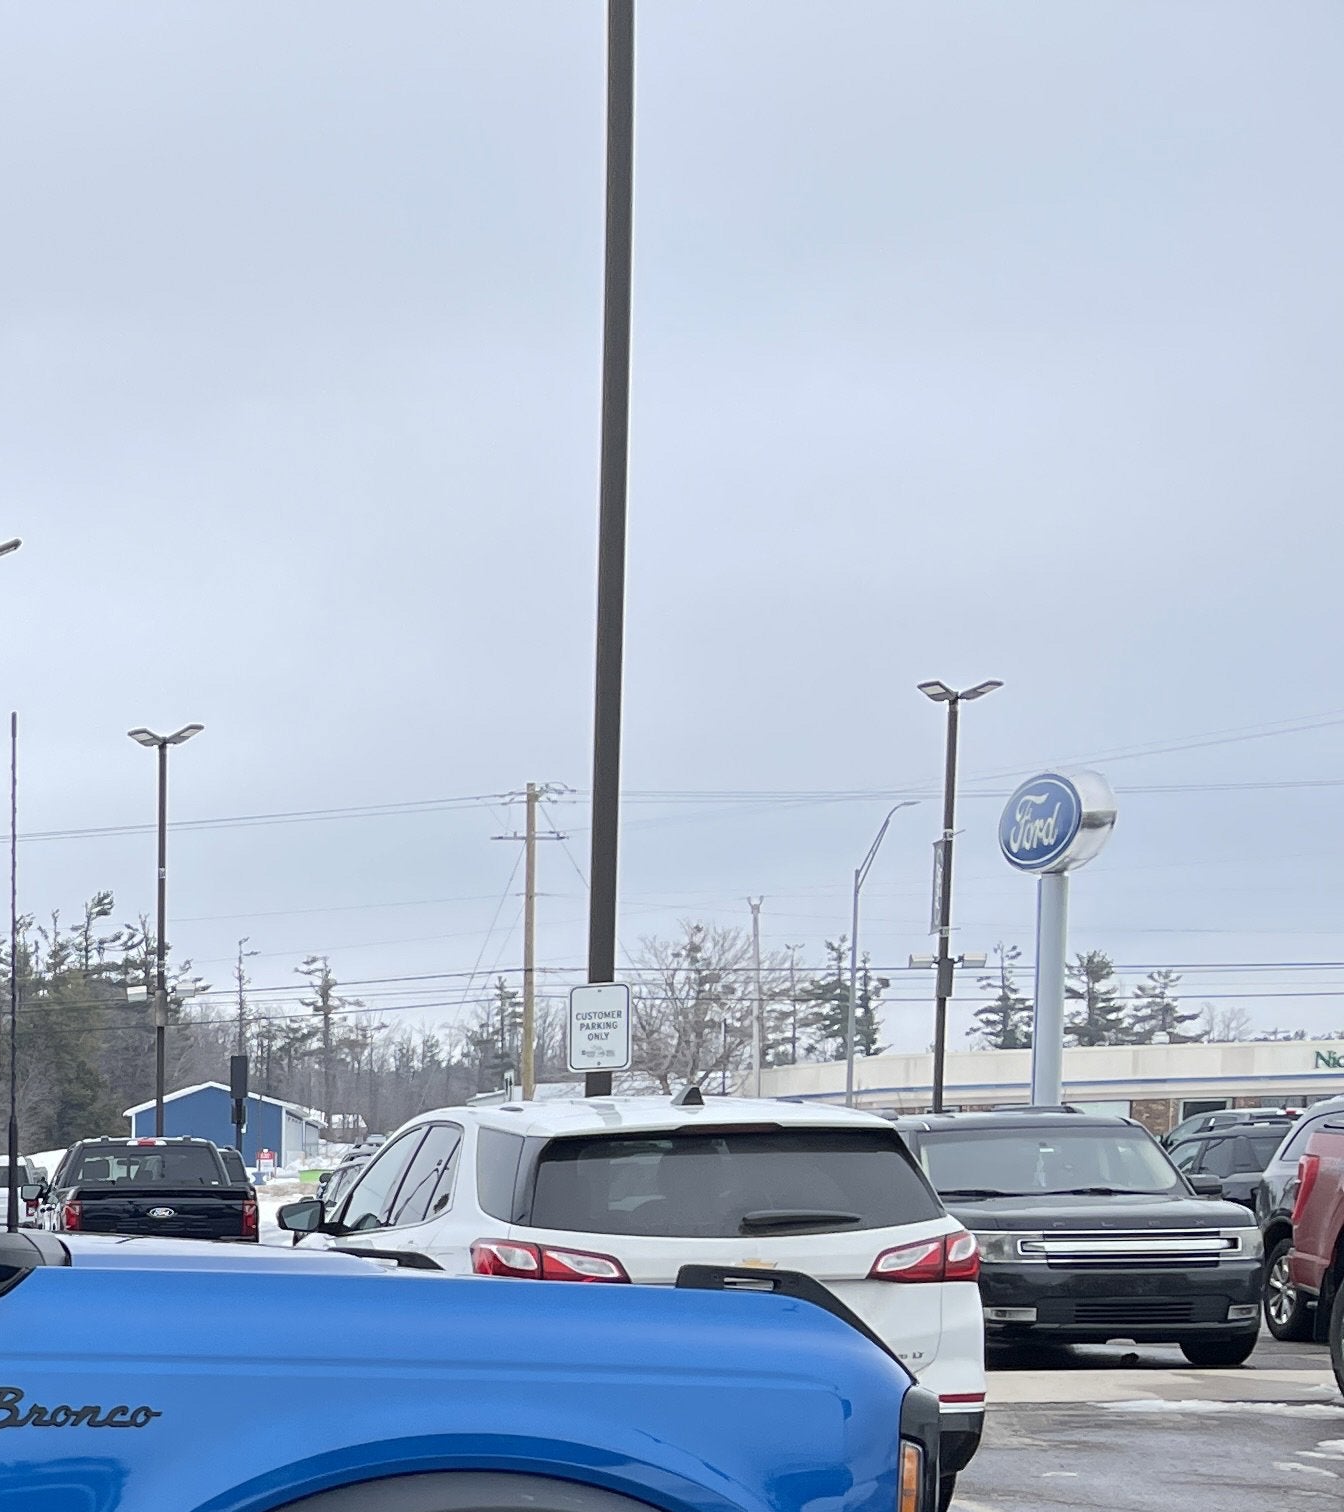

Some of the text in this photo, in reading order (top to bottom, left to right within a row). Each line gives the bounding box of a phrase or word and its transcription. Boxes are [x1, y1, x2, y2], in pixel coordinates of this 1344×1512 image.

[1009, 792, 1062, 854] Ford
[575, 1010, 623, 1021] CUSTOMER
[579, 1021, 618, 1031] PARKING
[587, 1032, 610, 1041] ONLY
